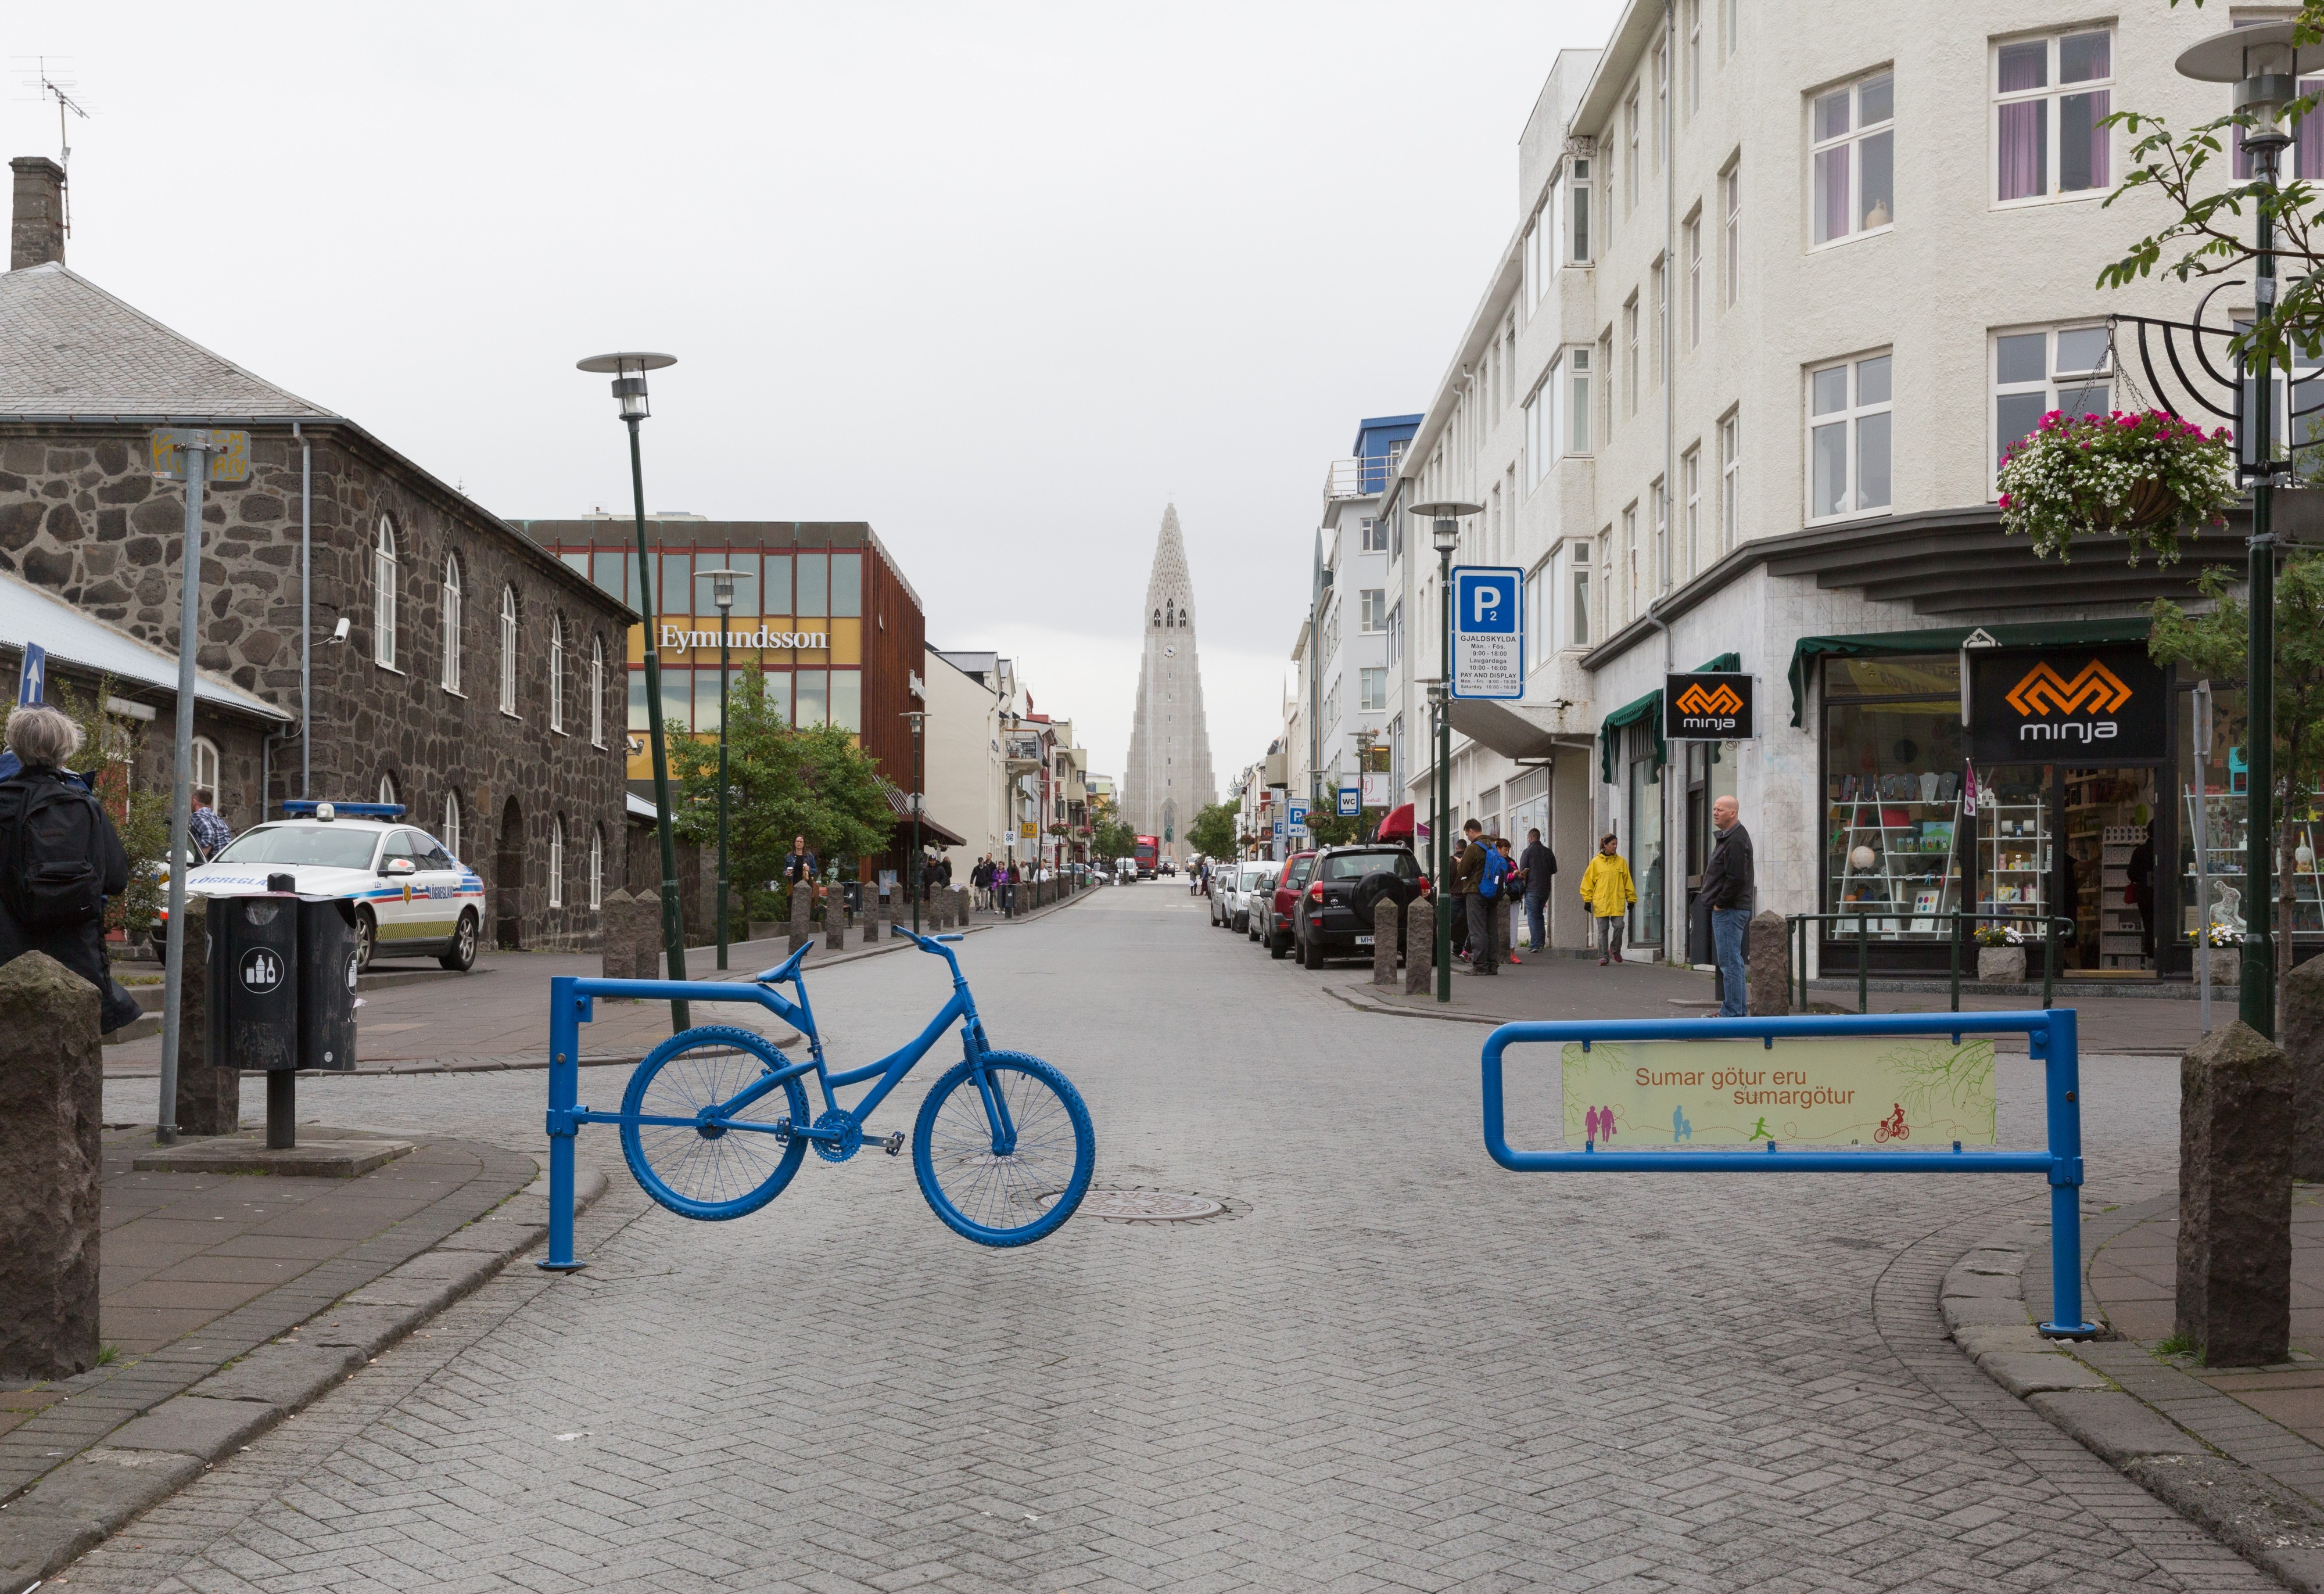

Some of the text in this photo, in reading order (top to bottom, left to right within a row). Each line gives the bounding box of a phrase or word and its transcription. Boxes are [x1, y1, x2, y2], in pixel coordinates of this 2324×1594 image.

[1475, 586, 1501, 622] P
[1490, 611, 1497, 621] 2
[660, 624, 829, 654] Eymundsson
[1684, 718, 1735, 730] minja
[2021, 722, 2117, 744] minja
[1294, 811, 1302, 821] P
[188, 876, 268, 886] LÖGREGLA
[429, 884, 453, 900] LÖGREGLAN
[1636, 1067, 1806, 1090] Sumar götur eru
[1734, 1087, 1855, 1109] sumargötur
